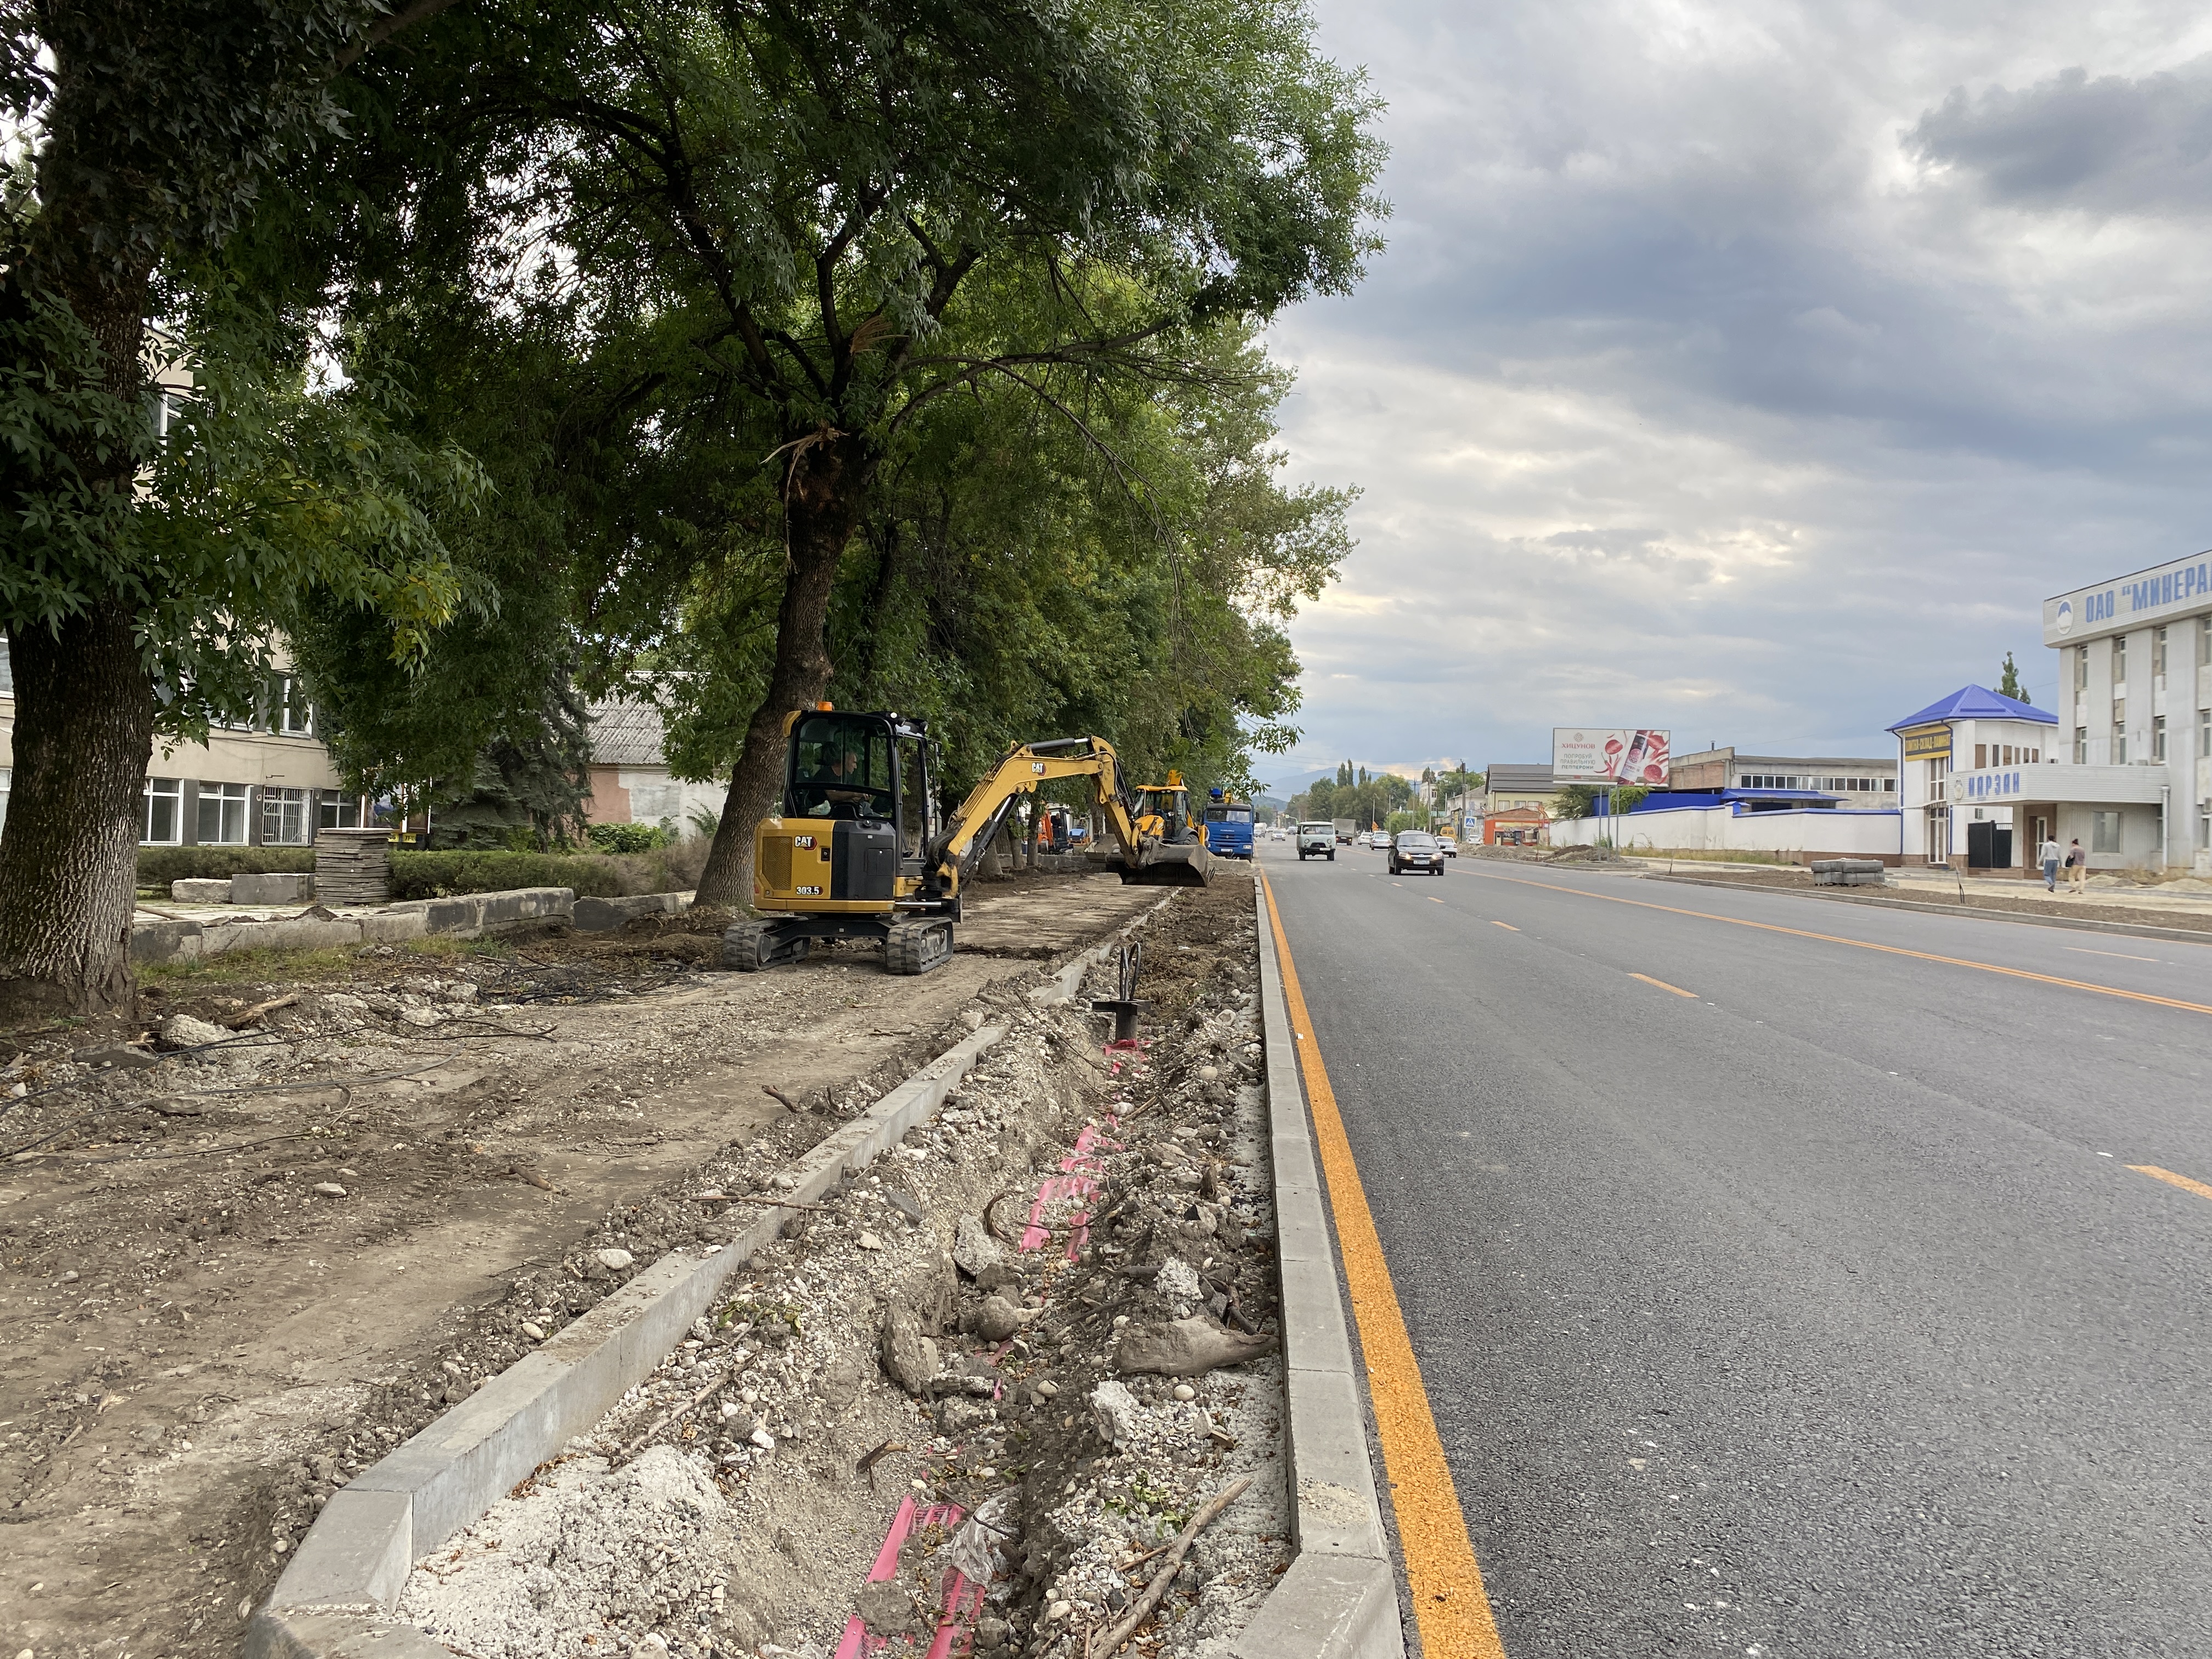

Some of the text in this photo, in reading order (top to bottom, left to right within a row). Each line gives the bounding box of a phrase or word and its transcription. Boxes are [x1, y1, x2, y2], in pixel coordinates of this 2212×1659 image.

[2086, 561, 2212, 623] ОАО "МИНЕРА
[1032, 763, 1043, 773] CAT
[1968, 772, 2019, 797] НАРЗАН
[795, 836, 812, 847] CAT
[797, 887, 819, 895] 303.5
